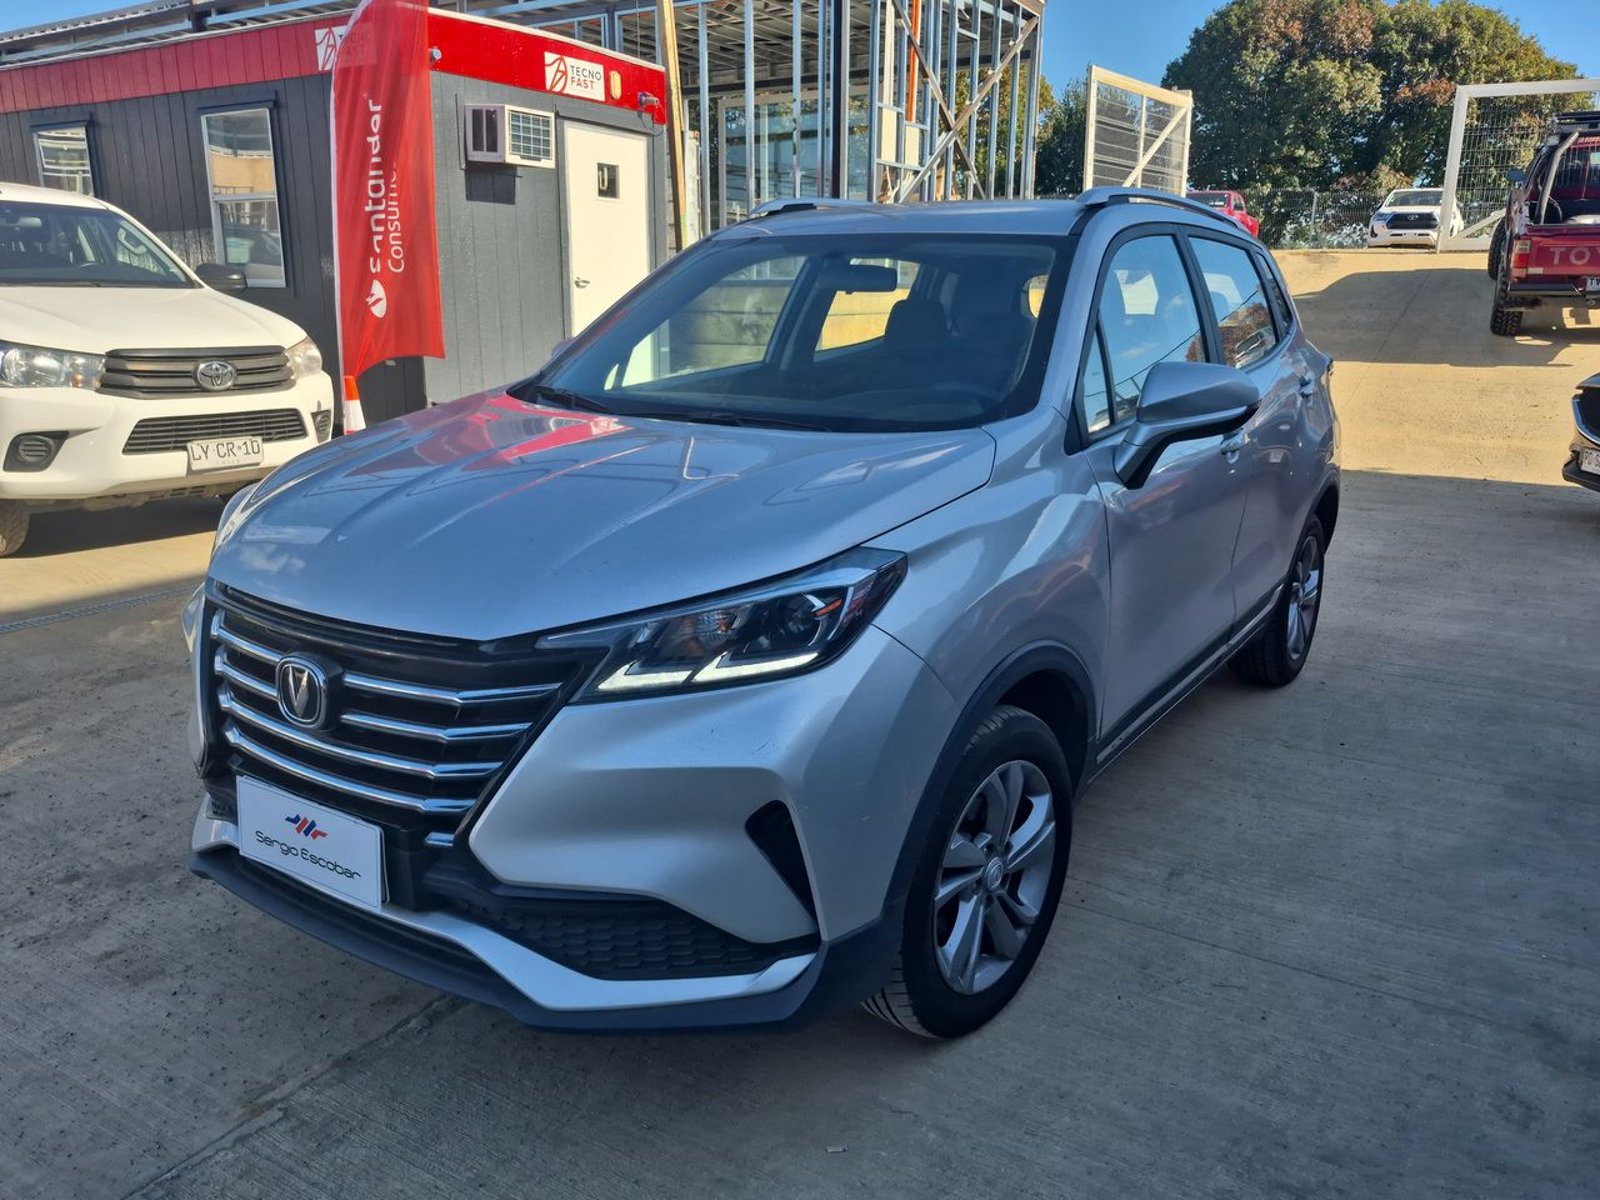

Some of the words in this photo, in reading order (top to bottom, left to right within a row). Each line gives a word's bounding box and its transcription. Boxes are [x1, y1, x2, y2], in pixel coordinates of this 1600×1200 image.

[569, 64, 602, 81] TECNO
[570, 76, 594, 90] FAST
[300, 848, 362, 880] Escobar
